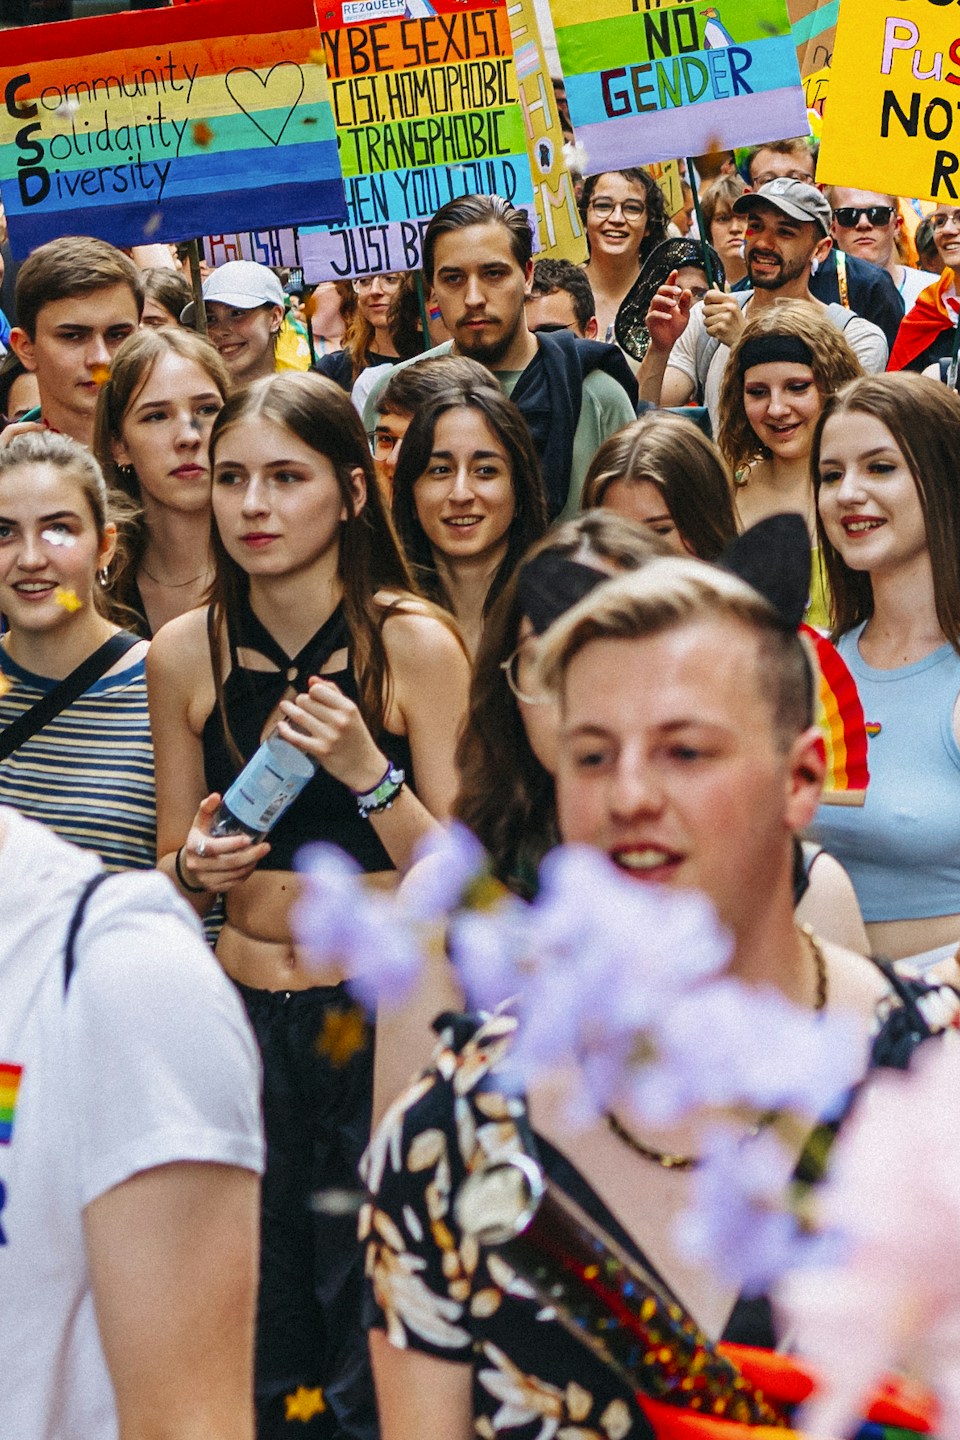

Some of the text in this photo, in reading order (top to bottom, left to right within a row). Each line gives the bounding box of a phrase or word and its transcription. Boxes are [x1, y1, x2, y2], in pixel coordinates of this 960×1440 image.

[347, 22, 394, 75] BE
[400, 9, 506, 68] SEXIST,
[643, 6, 699, 61] NO
[4, 51, 199, 120] Community
[332, 74, 386, 127] CIST,
[600, 47, 755, 119] GENDER
[15, 101, 189, 167] Solidarity
[347, 110, 511, 176] TRANSPHOBIC
[17, 153, 172, 207] Diversity
[343, 173, 389, 227] HEN
[394, 167, 441, 219] YOU
[329, 223, 392, 277] JUST
